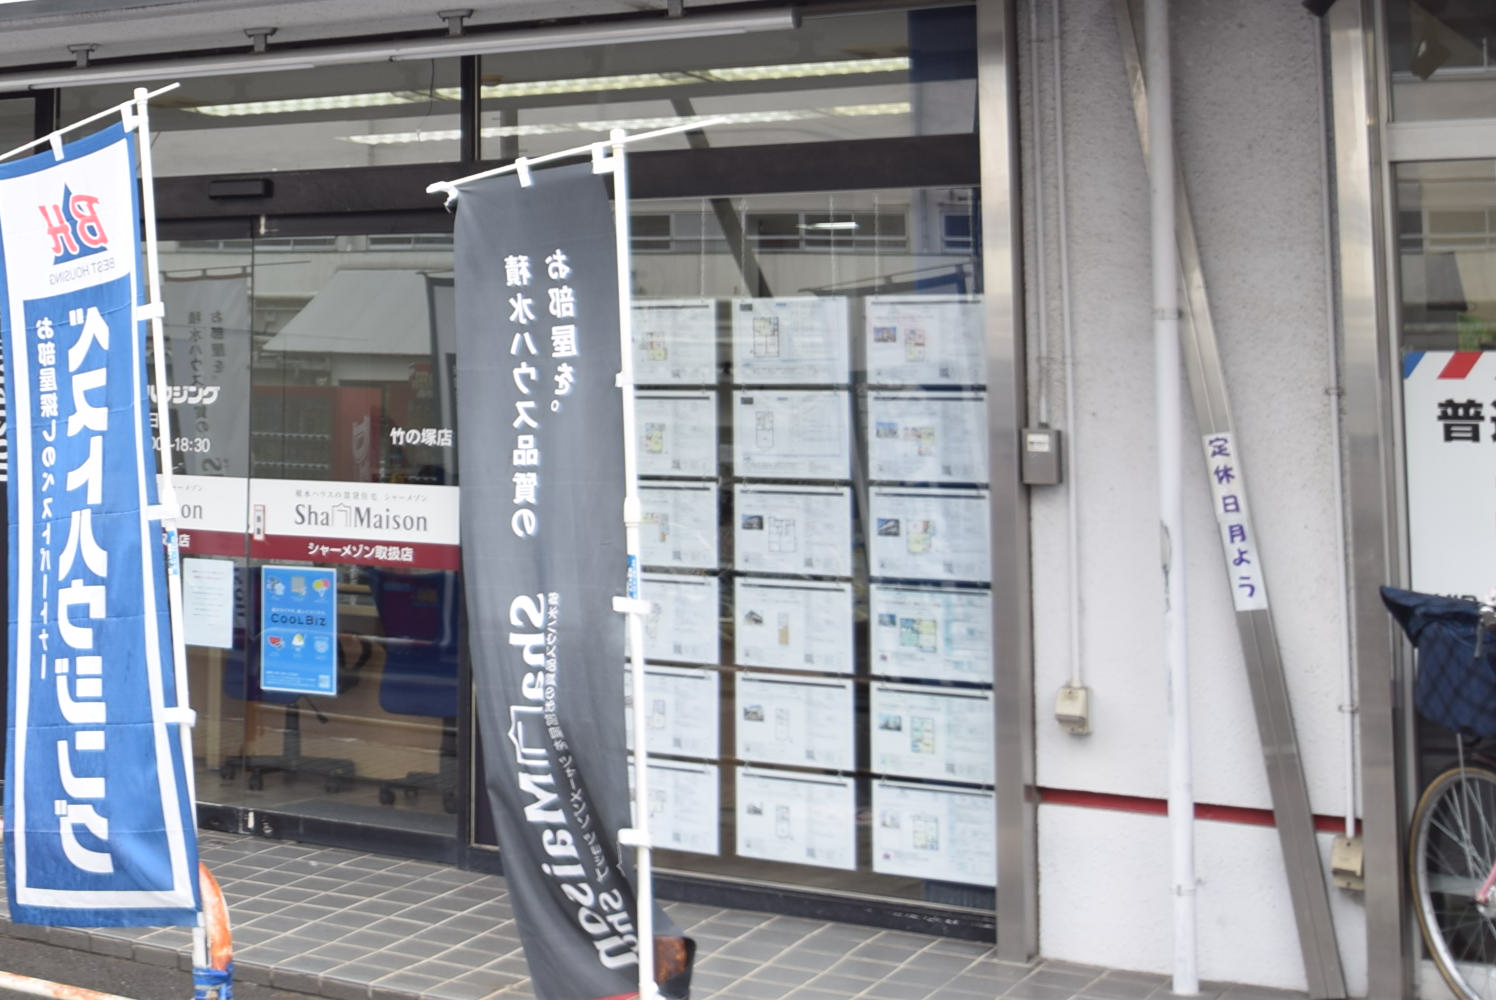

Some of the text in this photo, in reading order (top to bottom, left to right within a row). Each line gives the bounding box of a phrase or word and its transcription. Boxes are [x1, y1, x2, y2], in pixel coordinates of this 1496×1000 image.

[1437, 399, 1496, 443] 普
[390, 426, 453, 447] 竹の塚店
[294, 504, 428, 532] Sha Maison
[1208, 437, 1255, 598] 定休日月よう
[307, 541, 414, 562] シャーメゾン取扱店
